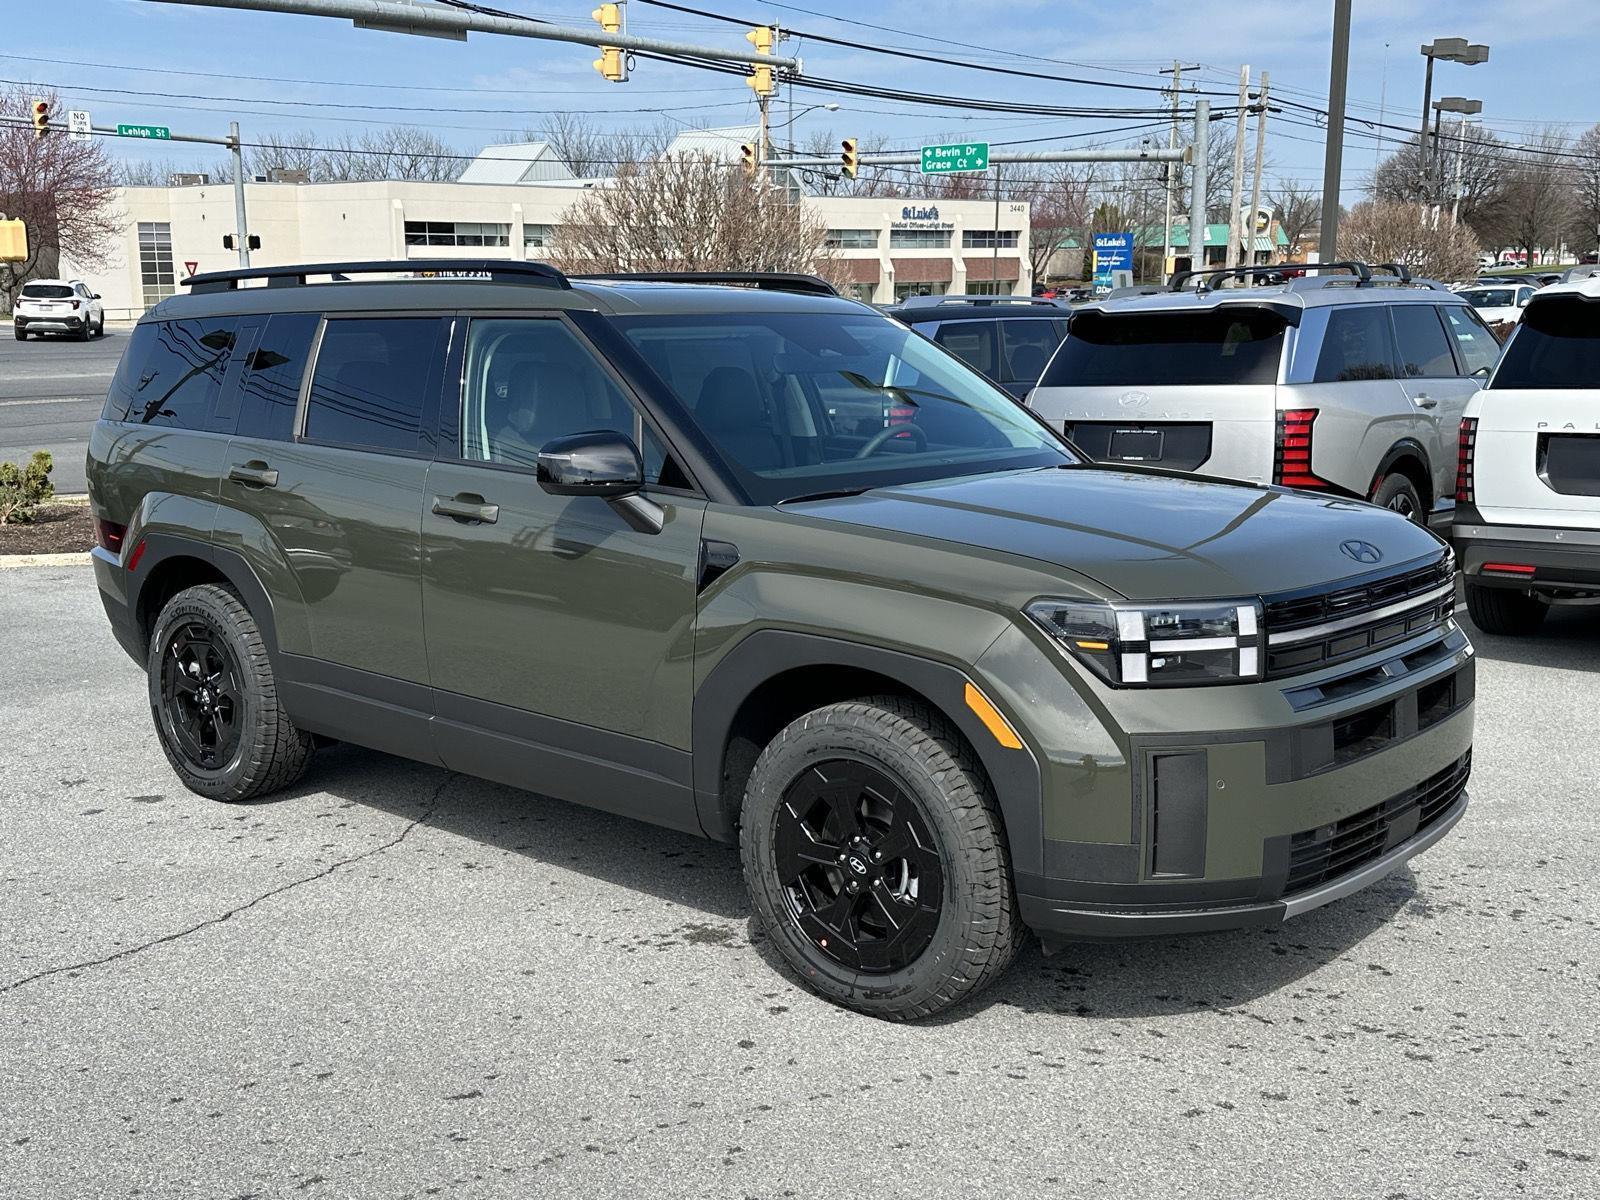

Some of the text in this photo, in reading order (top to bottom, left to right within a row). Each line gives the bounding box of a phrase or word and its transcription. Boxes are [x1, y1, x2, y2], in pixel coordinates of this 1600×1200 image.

[73, 112, 86, 120] NO
[122, 127, 166, 137] Lehigh St
[935, 146, 978, 158] Bevin Dr
[925, 158, 968, 170] Grace Ct
[1009, 204, 1024, 212] 3440
